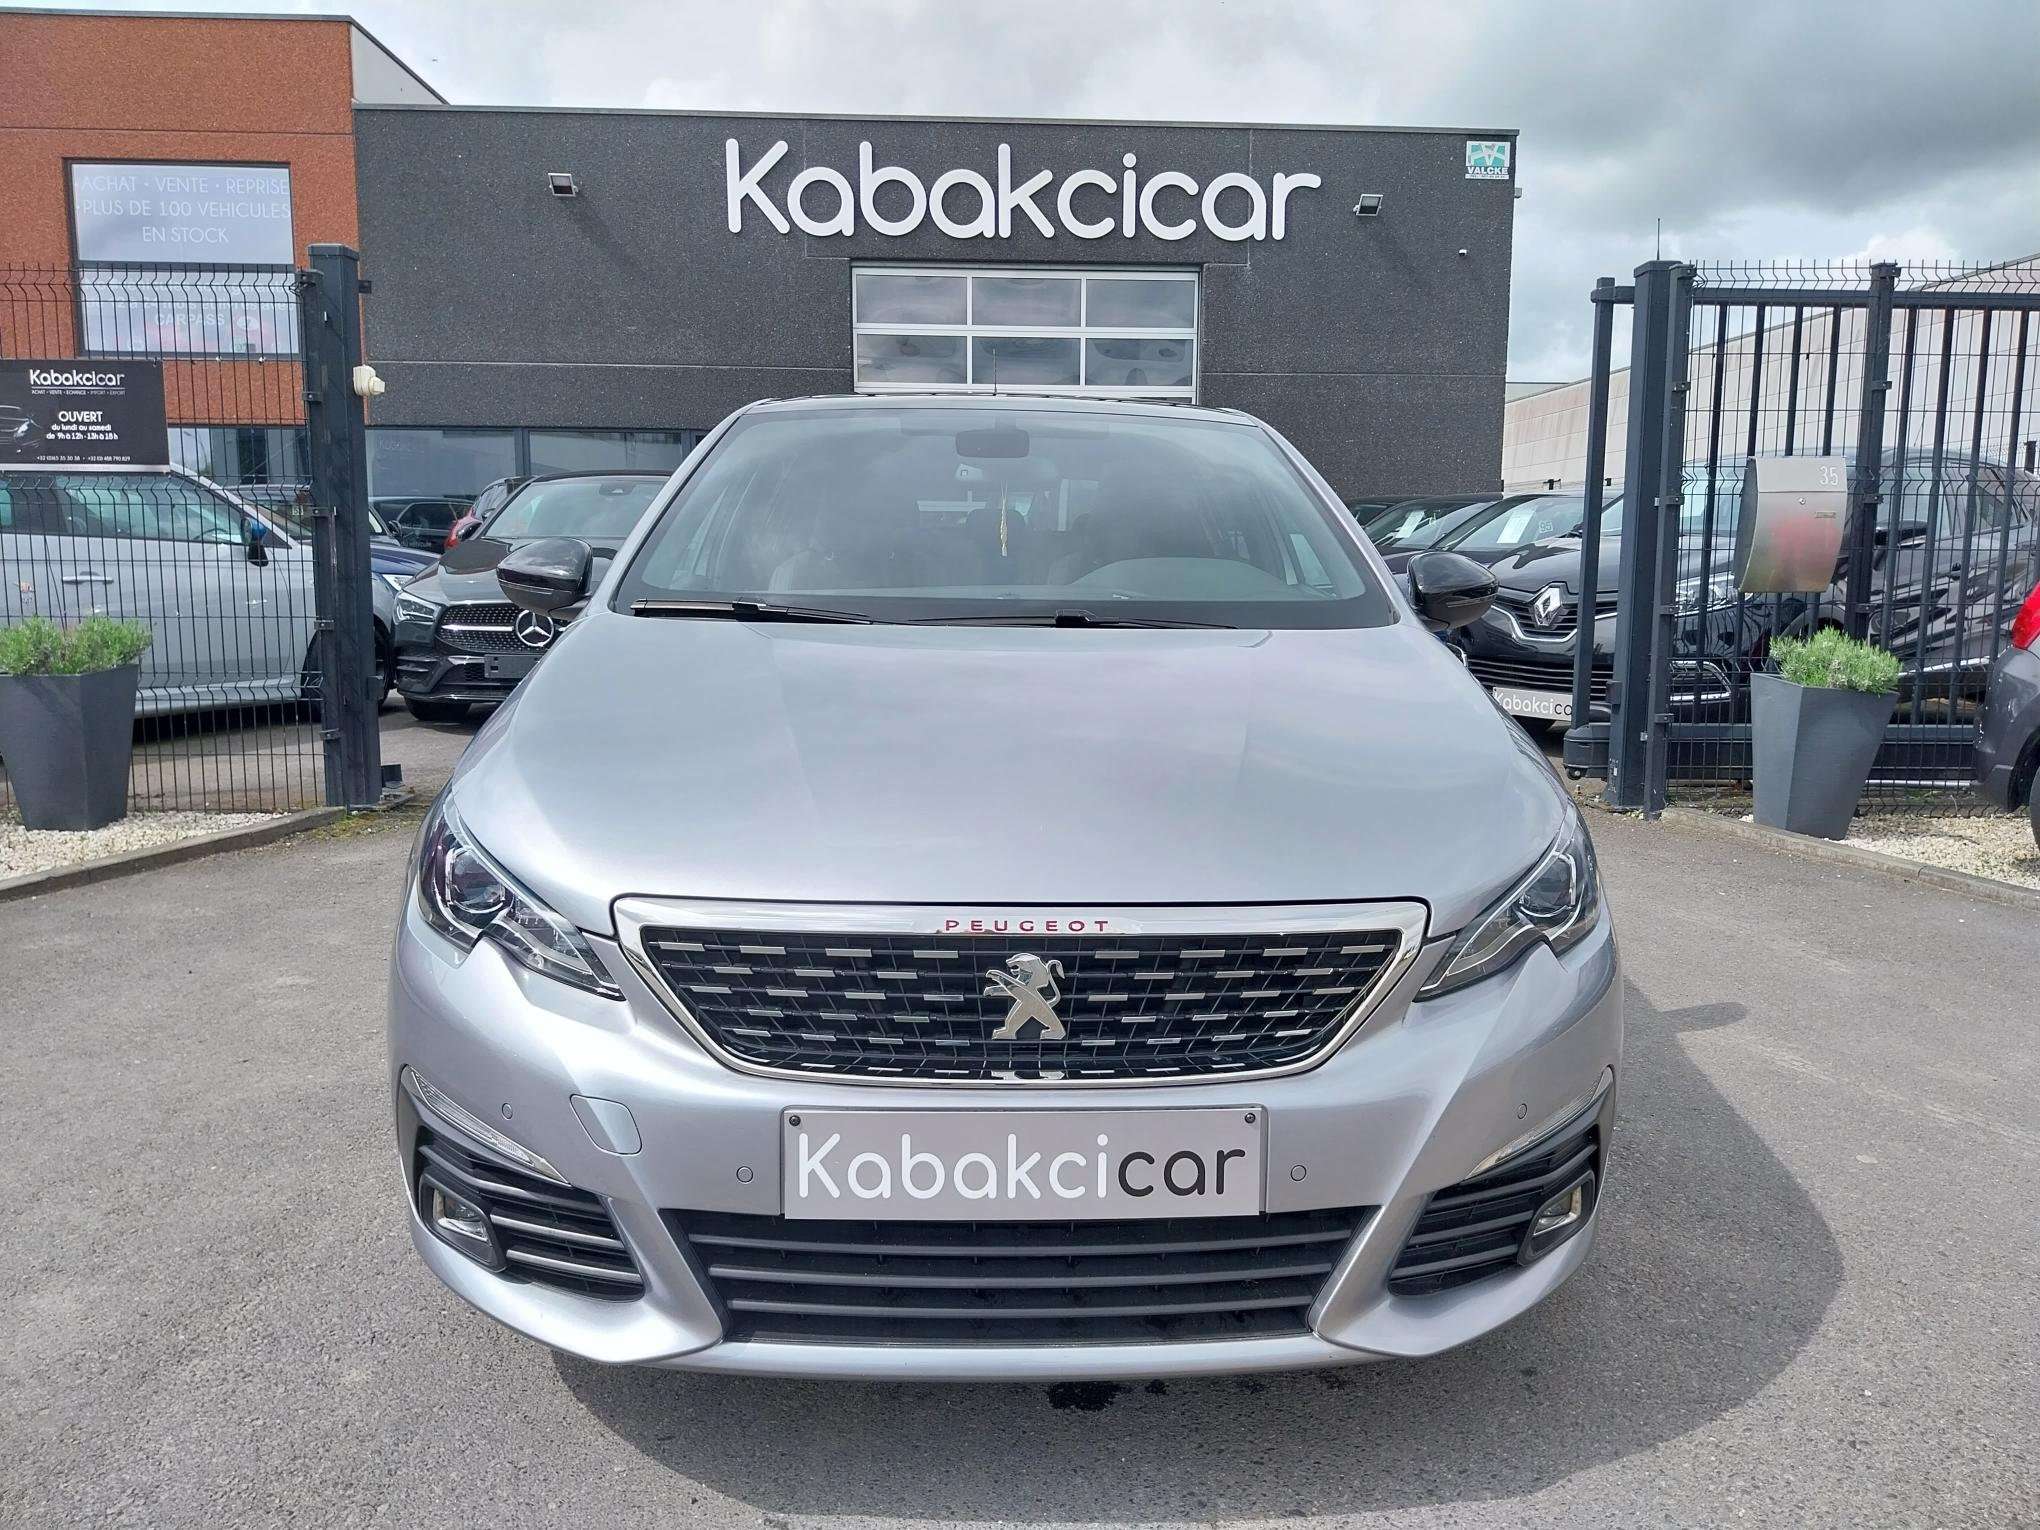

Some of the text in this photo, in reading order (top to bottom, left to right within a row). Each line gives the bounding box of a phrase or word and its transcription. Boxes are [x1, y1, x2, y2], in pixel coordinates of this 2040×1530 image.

[1467, 166, 1509, 175] VALCKE
[81, 176, 289, 195] ACHAT VENTE REPRISE
[725, 138, 1322, 241] Kabakcicar
[83, 200, 291, 218] PLUS DE 100 VEHICULES
[143, 226, 229, 243] EN STOCK
[29, 369, 125, 386] Kabakcicar
[58, 410, 103, 422] OUVERT
[1819, 465, 1839, 486] 35
[945, 919, 1109, 932] PEUGEOT
[799, 1132, 1246, 1199] Kabakcicar
